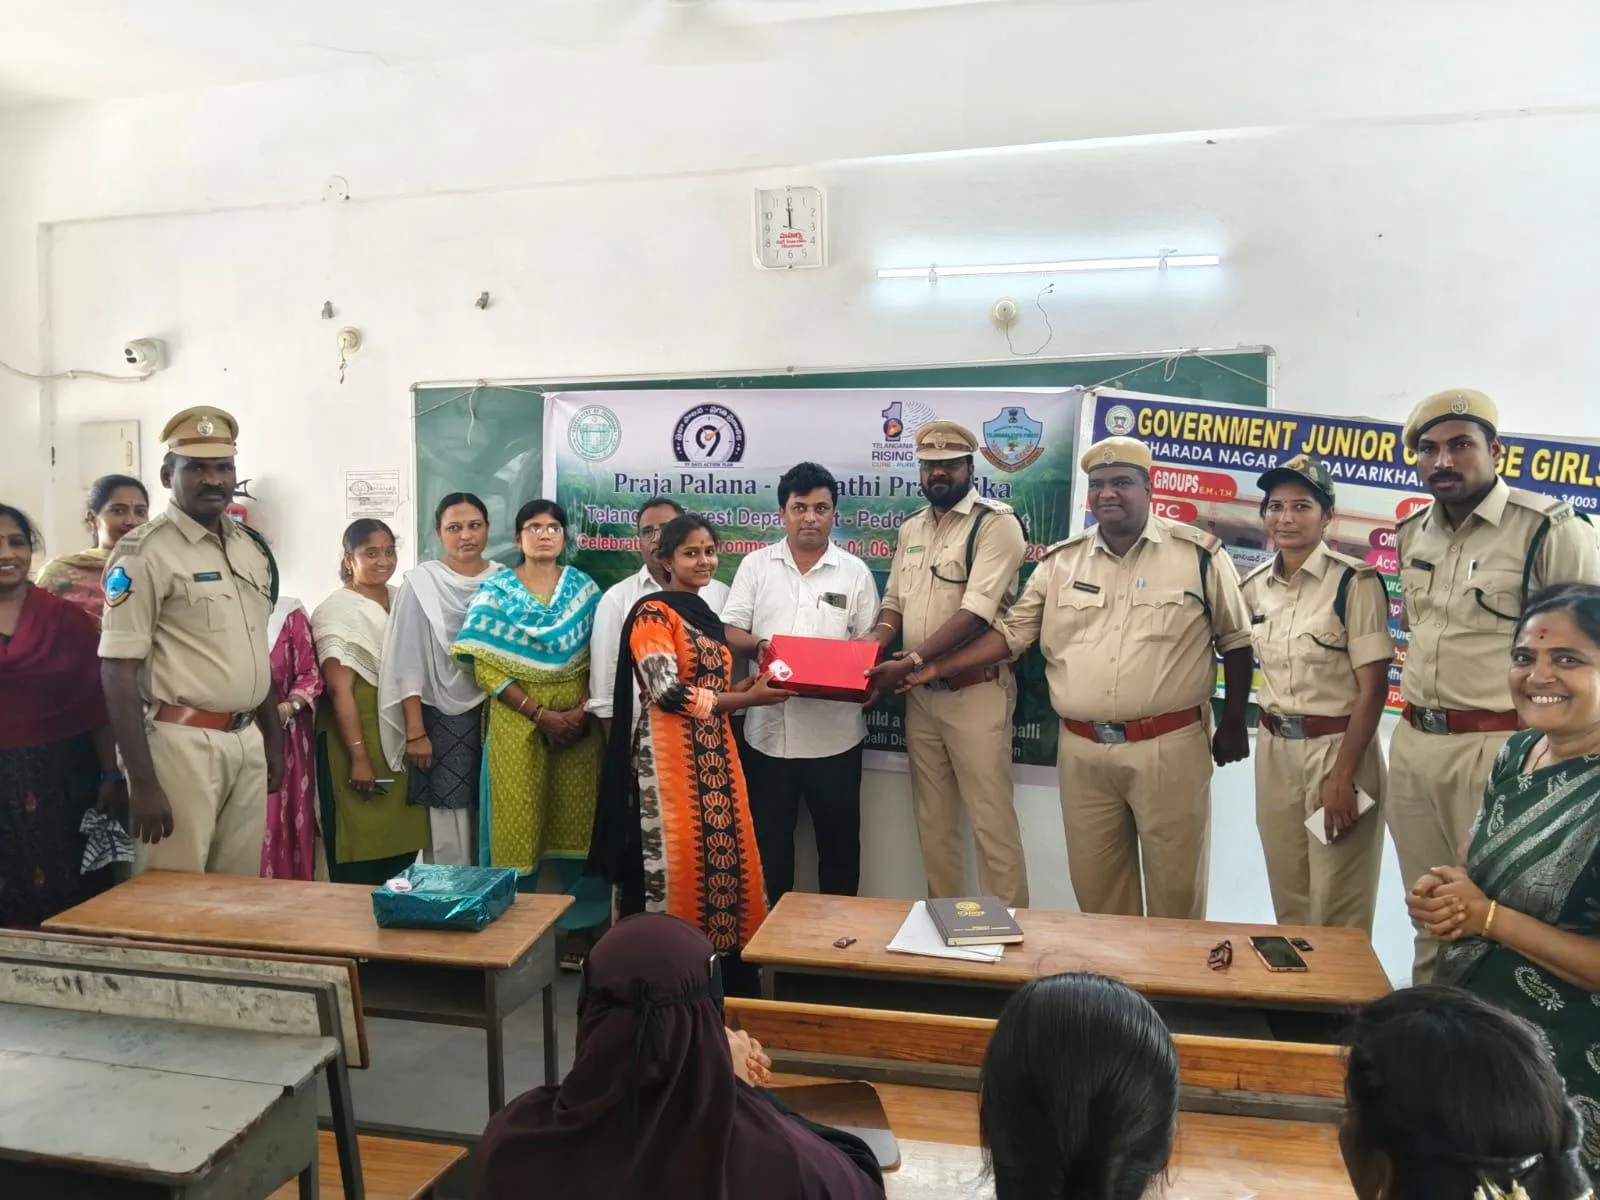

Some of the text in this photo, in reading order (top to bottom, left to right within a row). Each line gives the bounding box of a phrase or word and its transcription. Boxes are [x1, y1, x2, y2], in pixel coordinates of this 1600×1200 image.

[1137, 407, 1298, 451] GOVERNMENT
[1301, 423, 1396, 463] JUNIOR
[871, 451, 914, 461] RISING
[1218, 449, 1278, 469] NAGAR
[614, 473, 672, 498] Praja
[680, 473, 757, 495] Palana
[1153, 469, 1199, 494] GROUPS
[587, 505, 639, 528] Telang
[857, 511, 904, 529] Pedd
[1150, 501, 1181, 519] PC
[578, 533, 640, 550] Celebrat
[1376, 554, 1397, 571] Acc
